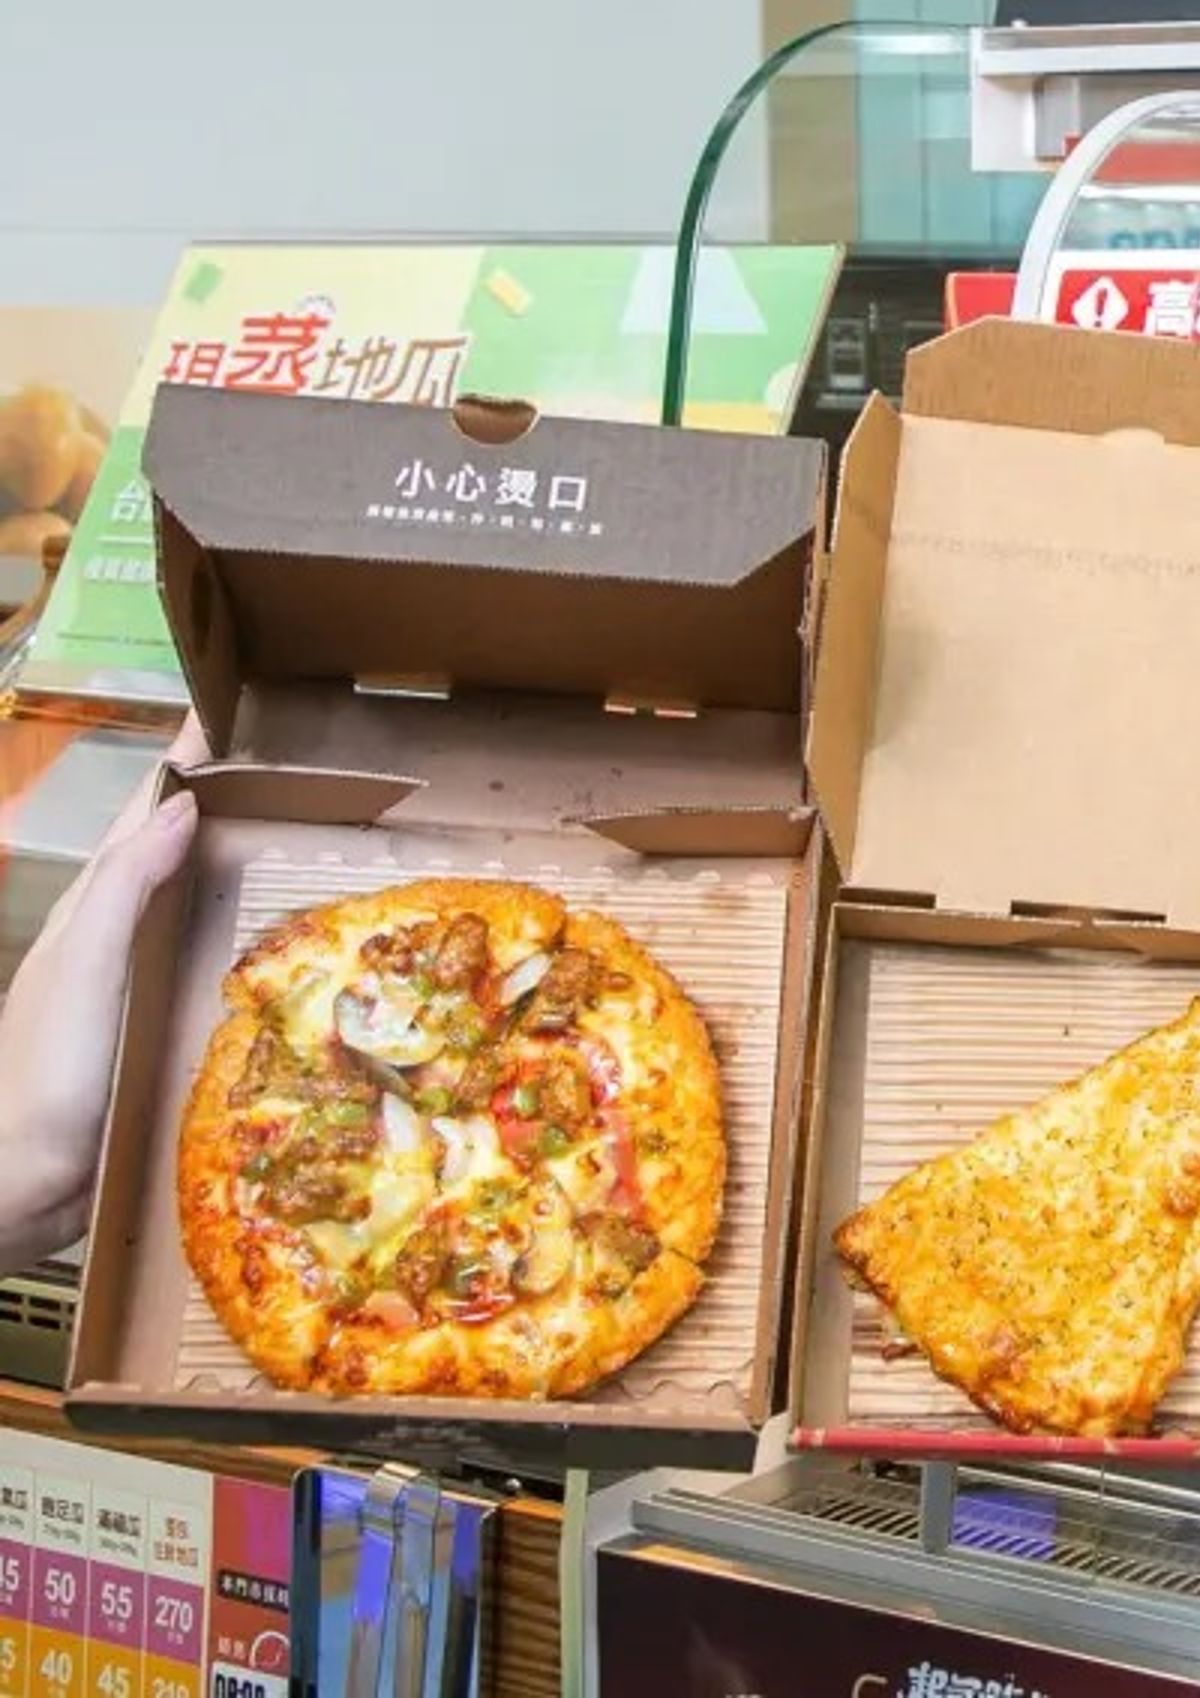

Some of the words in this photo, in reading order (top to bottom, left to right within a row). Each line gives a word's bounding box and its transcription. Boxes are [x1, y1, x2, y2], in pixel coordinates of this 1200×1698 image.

[394, 459, 588, 512] 小心燙口
[44, 1568, 76, 1605] 50
[101, 1582, 133, 1619] 55
[155, 1596, 193, 1632] 270
[41, 1650, 73, 1685] 40
[97, 1662, 130, 1698] 45
